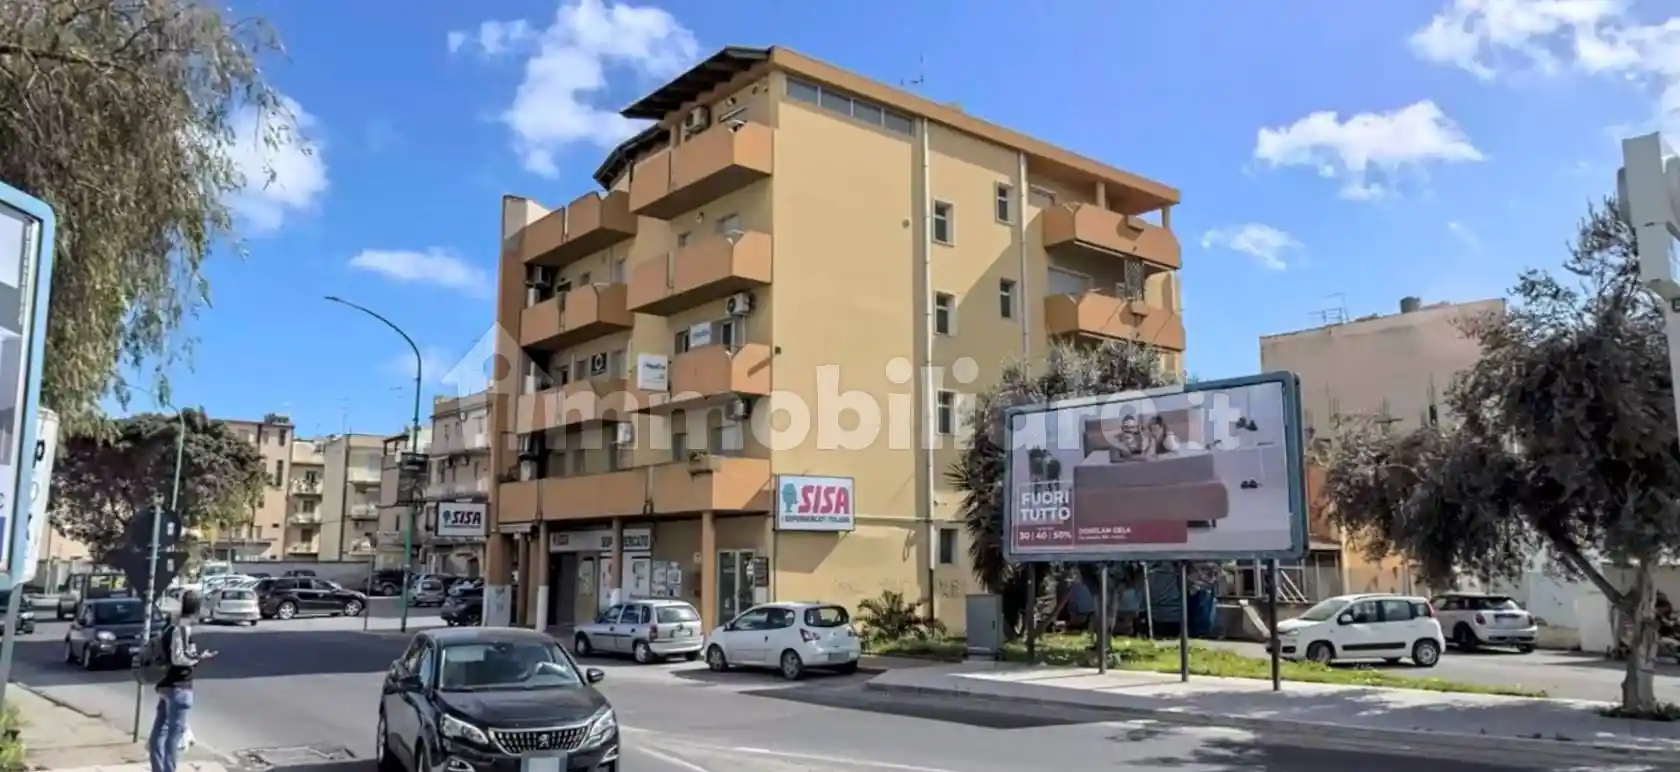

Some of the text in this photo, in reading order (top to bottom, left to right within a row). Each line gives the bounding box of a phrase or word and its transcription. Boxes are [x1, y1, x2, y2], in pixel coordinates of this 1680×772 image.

[798, 485, 850, 514] SISA
[1021, 490, 1070, 506] FUORI
[451, 511, 481, 525] SISA
[1020, 507, 1071, 521] TUTTO
